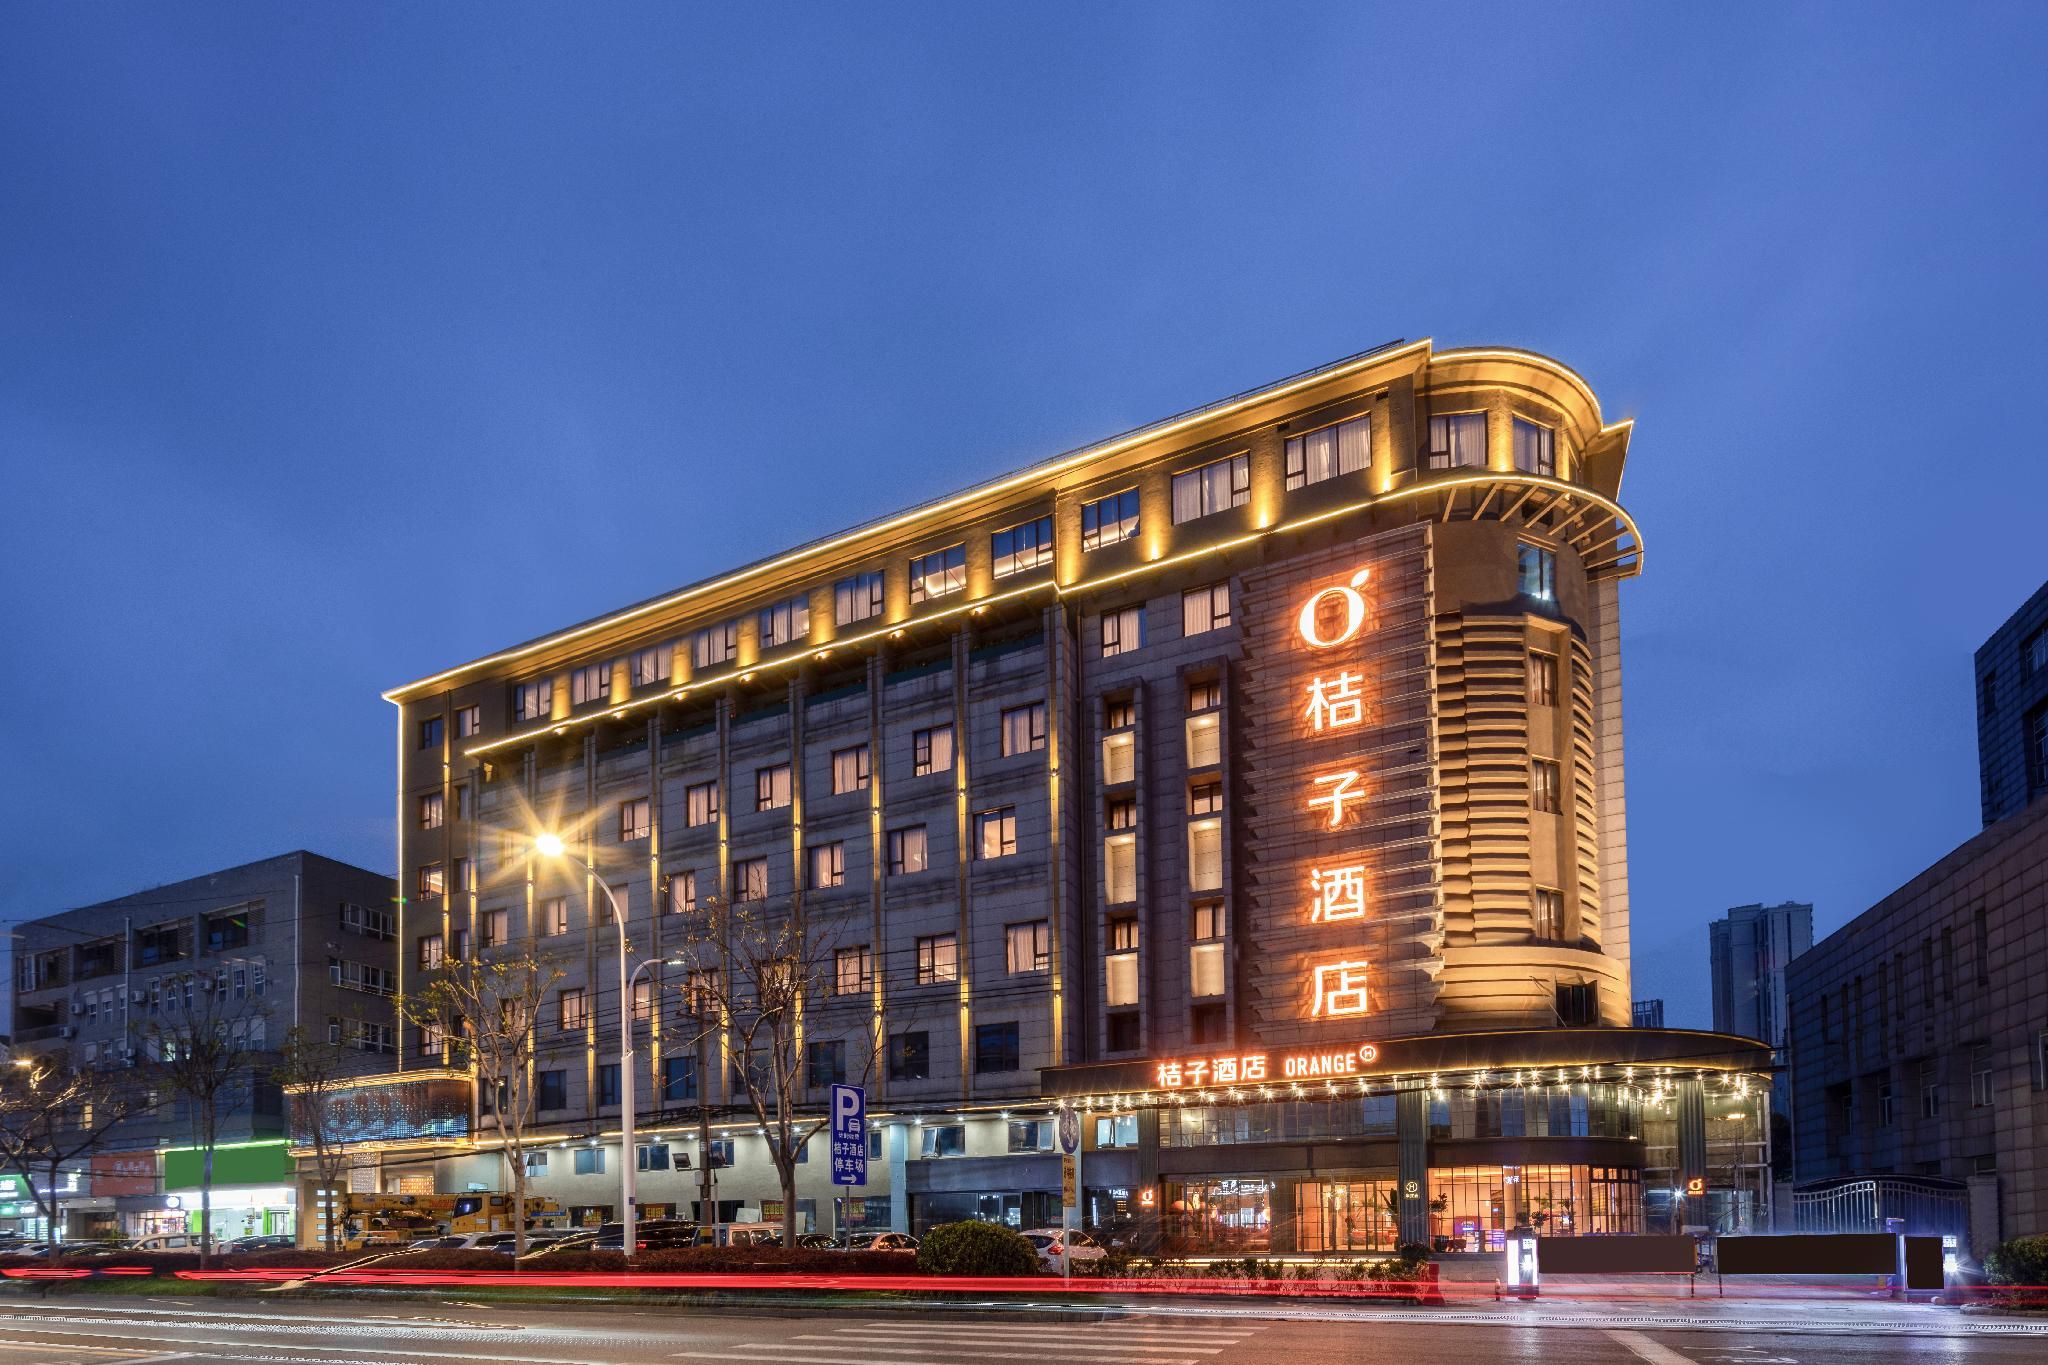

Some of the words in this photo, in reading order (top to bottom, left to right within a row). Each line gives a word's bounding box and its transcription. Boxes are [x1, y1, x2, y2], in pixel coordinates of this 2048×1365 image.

[1305, 672, 1369, 1017] 桔子酒店
[1157, 1056, 1266, 1087] 桔子酒店
[1285, 1053, 1357, 1077] ORANGE
[836, 1088, 860, 1131] P
[834, 1142, 864, 1157] 桔子酒店
[834, 1157, 864, 1173] 停车场
